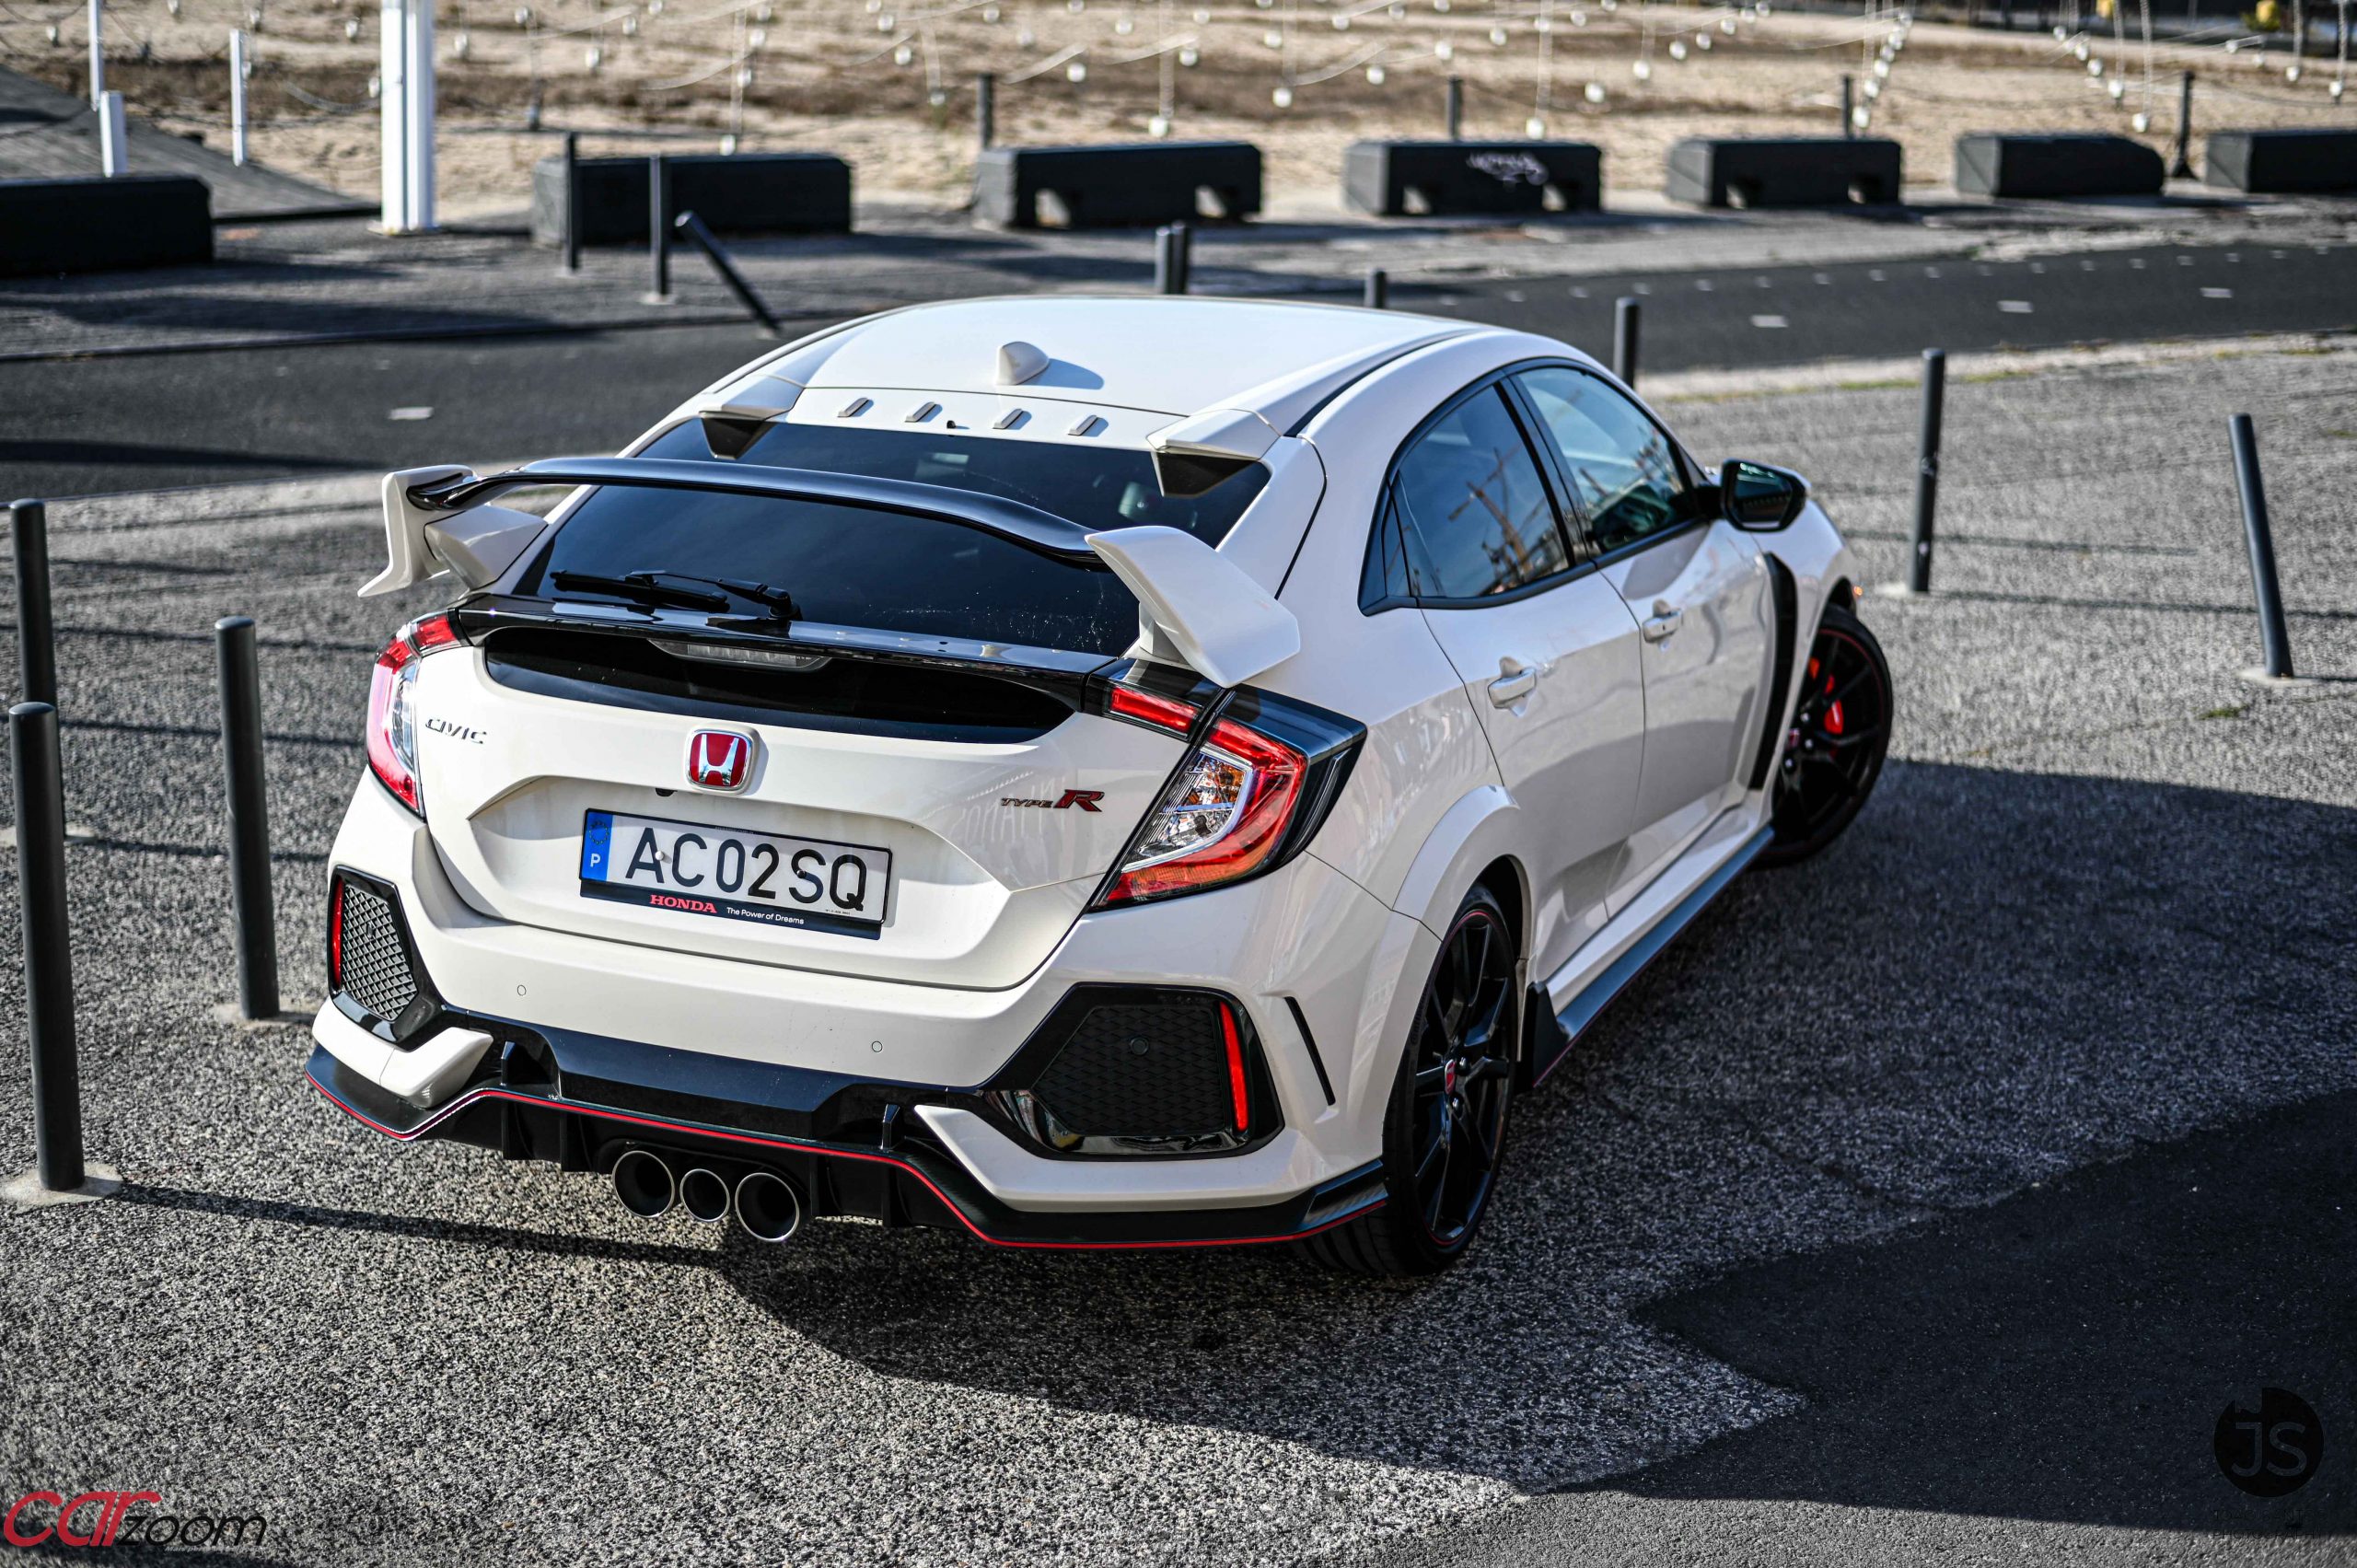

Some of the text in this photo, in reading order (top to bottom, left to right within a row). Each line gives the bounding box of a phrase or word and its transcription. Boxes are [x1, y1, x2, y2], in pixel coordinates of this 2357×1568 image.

[425, 719, 486, 744] CIVIC
[1001, 789, 1105, 812] TYPE R
[590, 854, 601, 867] P
[649, 894, 717, 913] HONDA
[726, 907, 740, 915] The
[741, 910, 765, 919] Power
[775, 914, 804, 924] Dreams
